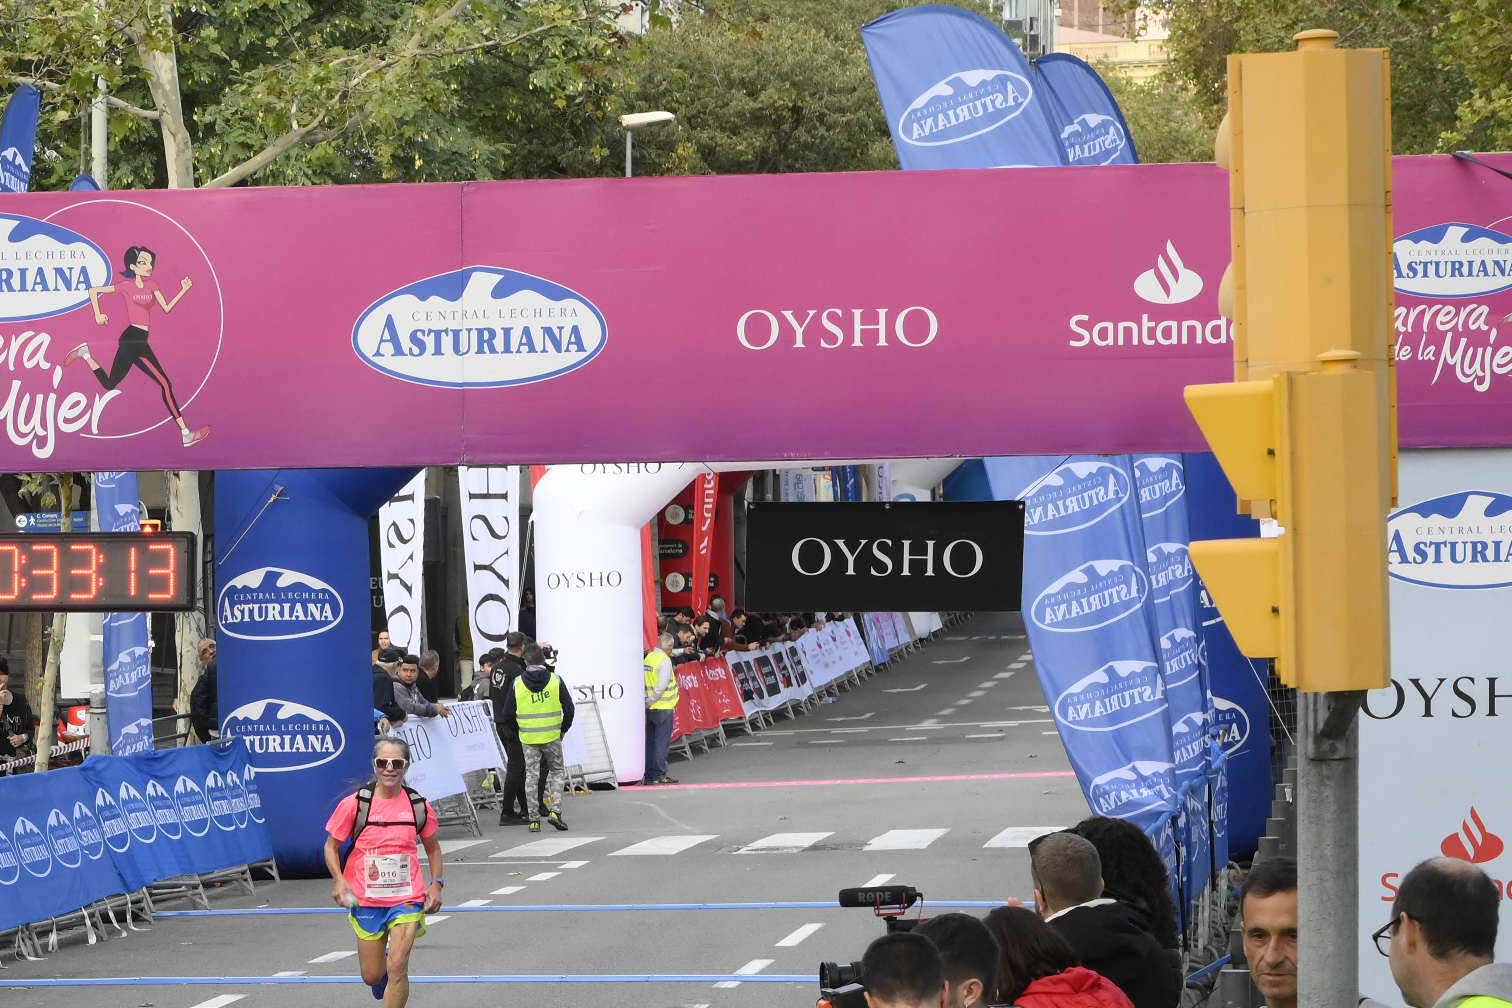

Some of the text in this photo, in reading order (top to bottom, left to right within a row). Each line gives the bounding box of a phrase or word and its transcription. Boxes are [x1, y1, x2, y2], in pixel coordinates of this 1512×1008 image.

[14, 249, 87, 262] LECHERA
[411, 306, 579, 322] CENTRAL LECHERA
[372, 313, 588, 358] ASTURIANA
[735, 306, 939, 352] OYSHO
[1068, 313, 1234, 348] Santand
[1417, 334, 1436, 361] la
[1430, 327, 1512, 393] Muje
[1414, 525, 1483, 536] CENTRAL
[790, 537, 984, 578] OYSHO
[1388, 529, 1512, 565] ASTURI
[546, 570, 623, 591] OYSHO
[234, 591, 330, 602] CENTRAL LECHERA
[222, 597, 335, 625] ASTURIANA
[577, 683, 625, 701] SHO
[281, 723, 331, 733] LECHERA
